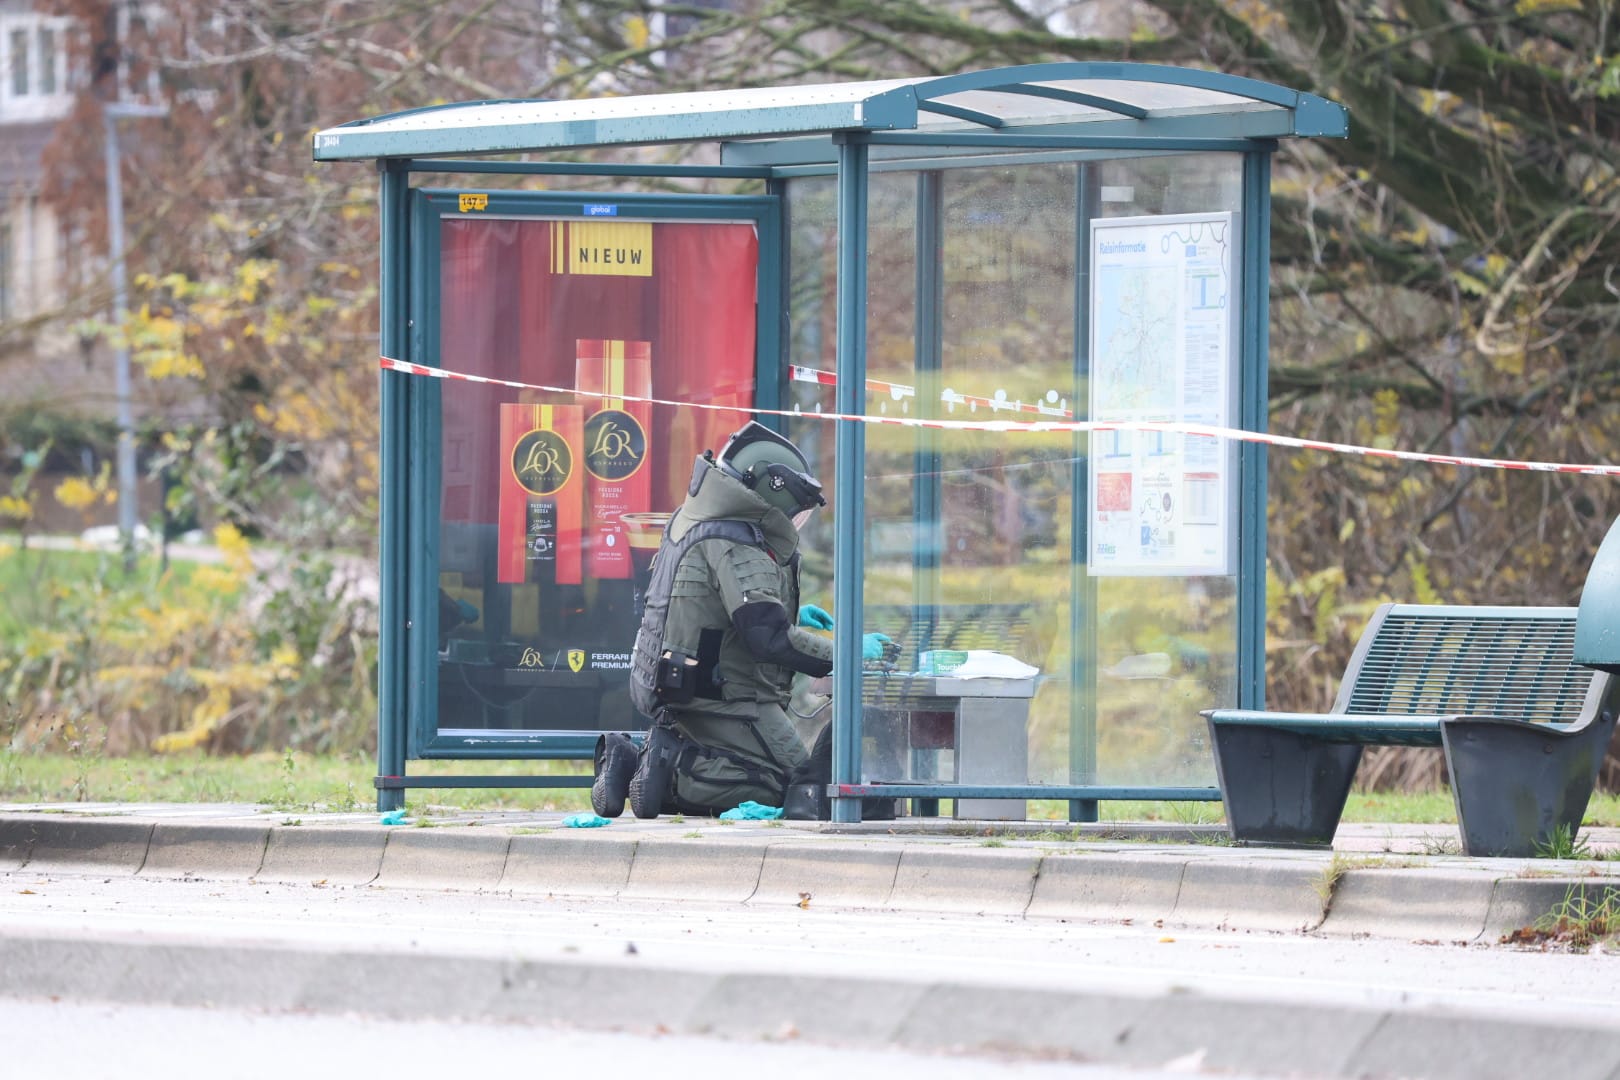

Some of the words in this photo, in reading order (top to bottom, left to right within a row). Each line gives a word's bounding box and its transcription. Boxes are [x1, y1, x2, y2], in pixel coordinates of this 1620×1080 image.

[461, 197, 478, 206] 147
[590, 206, 611, 215] global
[579, 247, 643, 264] NIEUW
